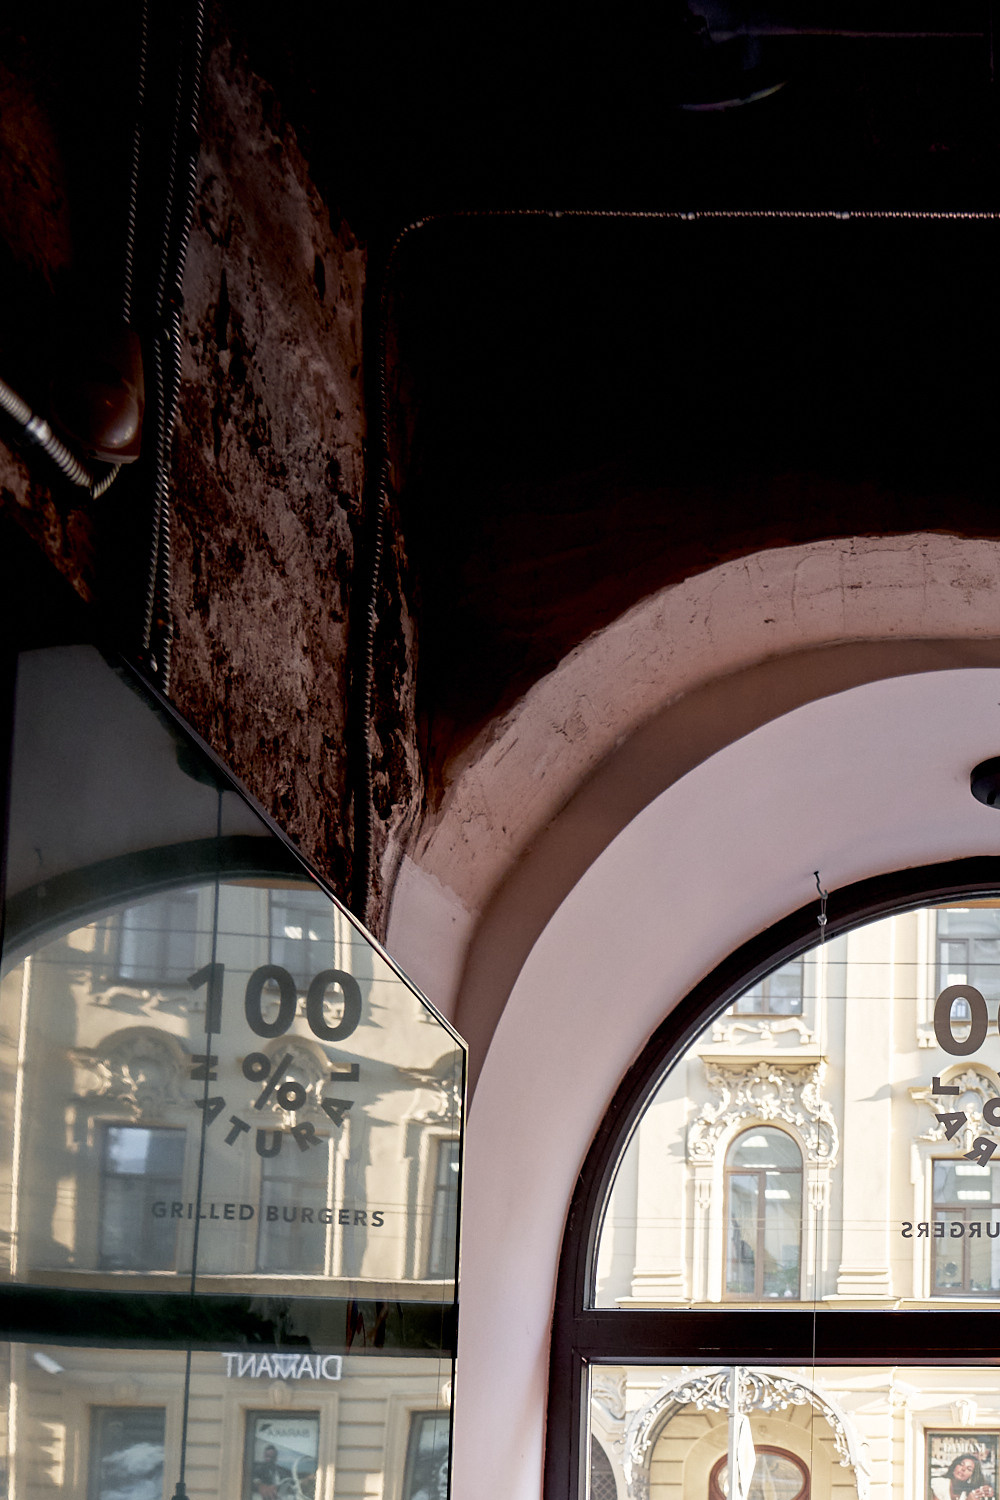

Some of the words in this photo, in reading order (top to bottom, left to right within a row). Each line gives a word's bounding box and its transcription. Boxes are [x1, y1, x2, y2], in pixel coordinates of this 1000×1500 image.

[187, 963, 362, 1041] 100
[190, 1054, 360, 1158] NATURAL
[151, 1201, 255, 1221] GRILLED
[265, 1205, 385, 1228] BURGERS
